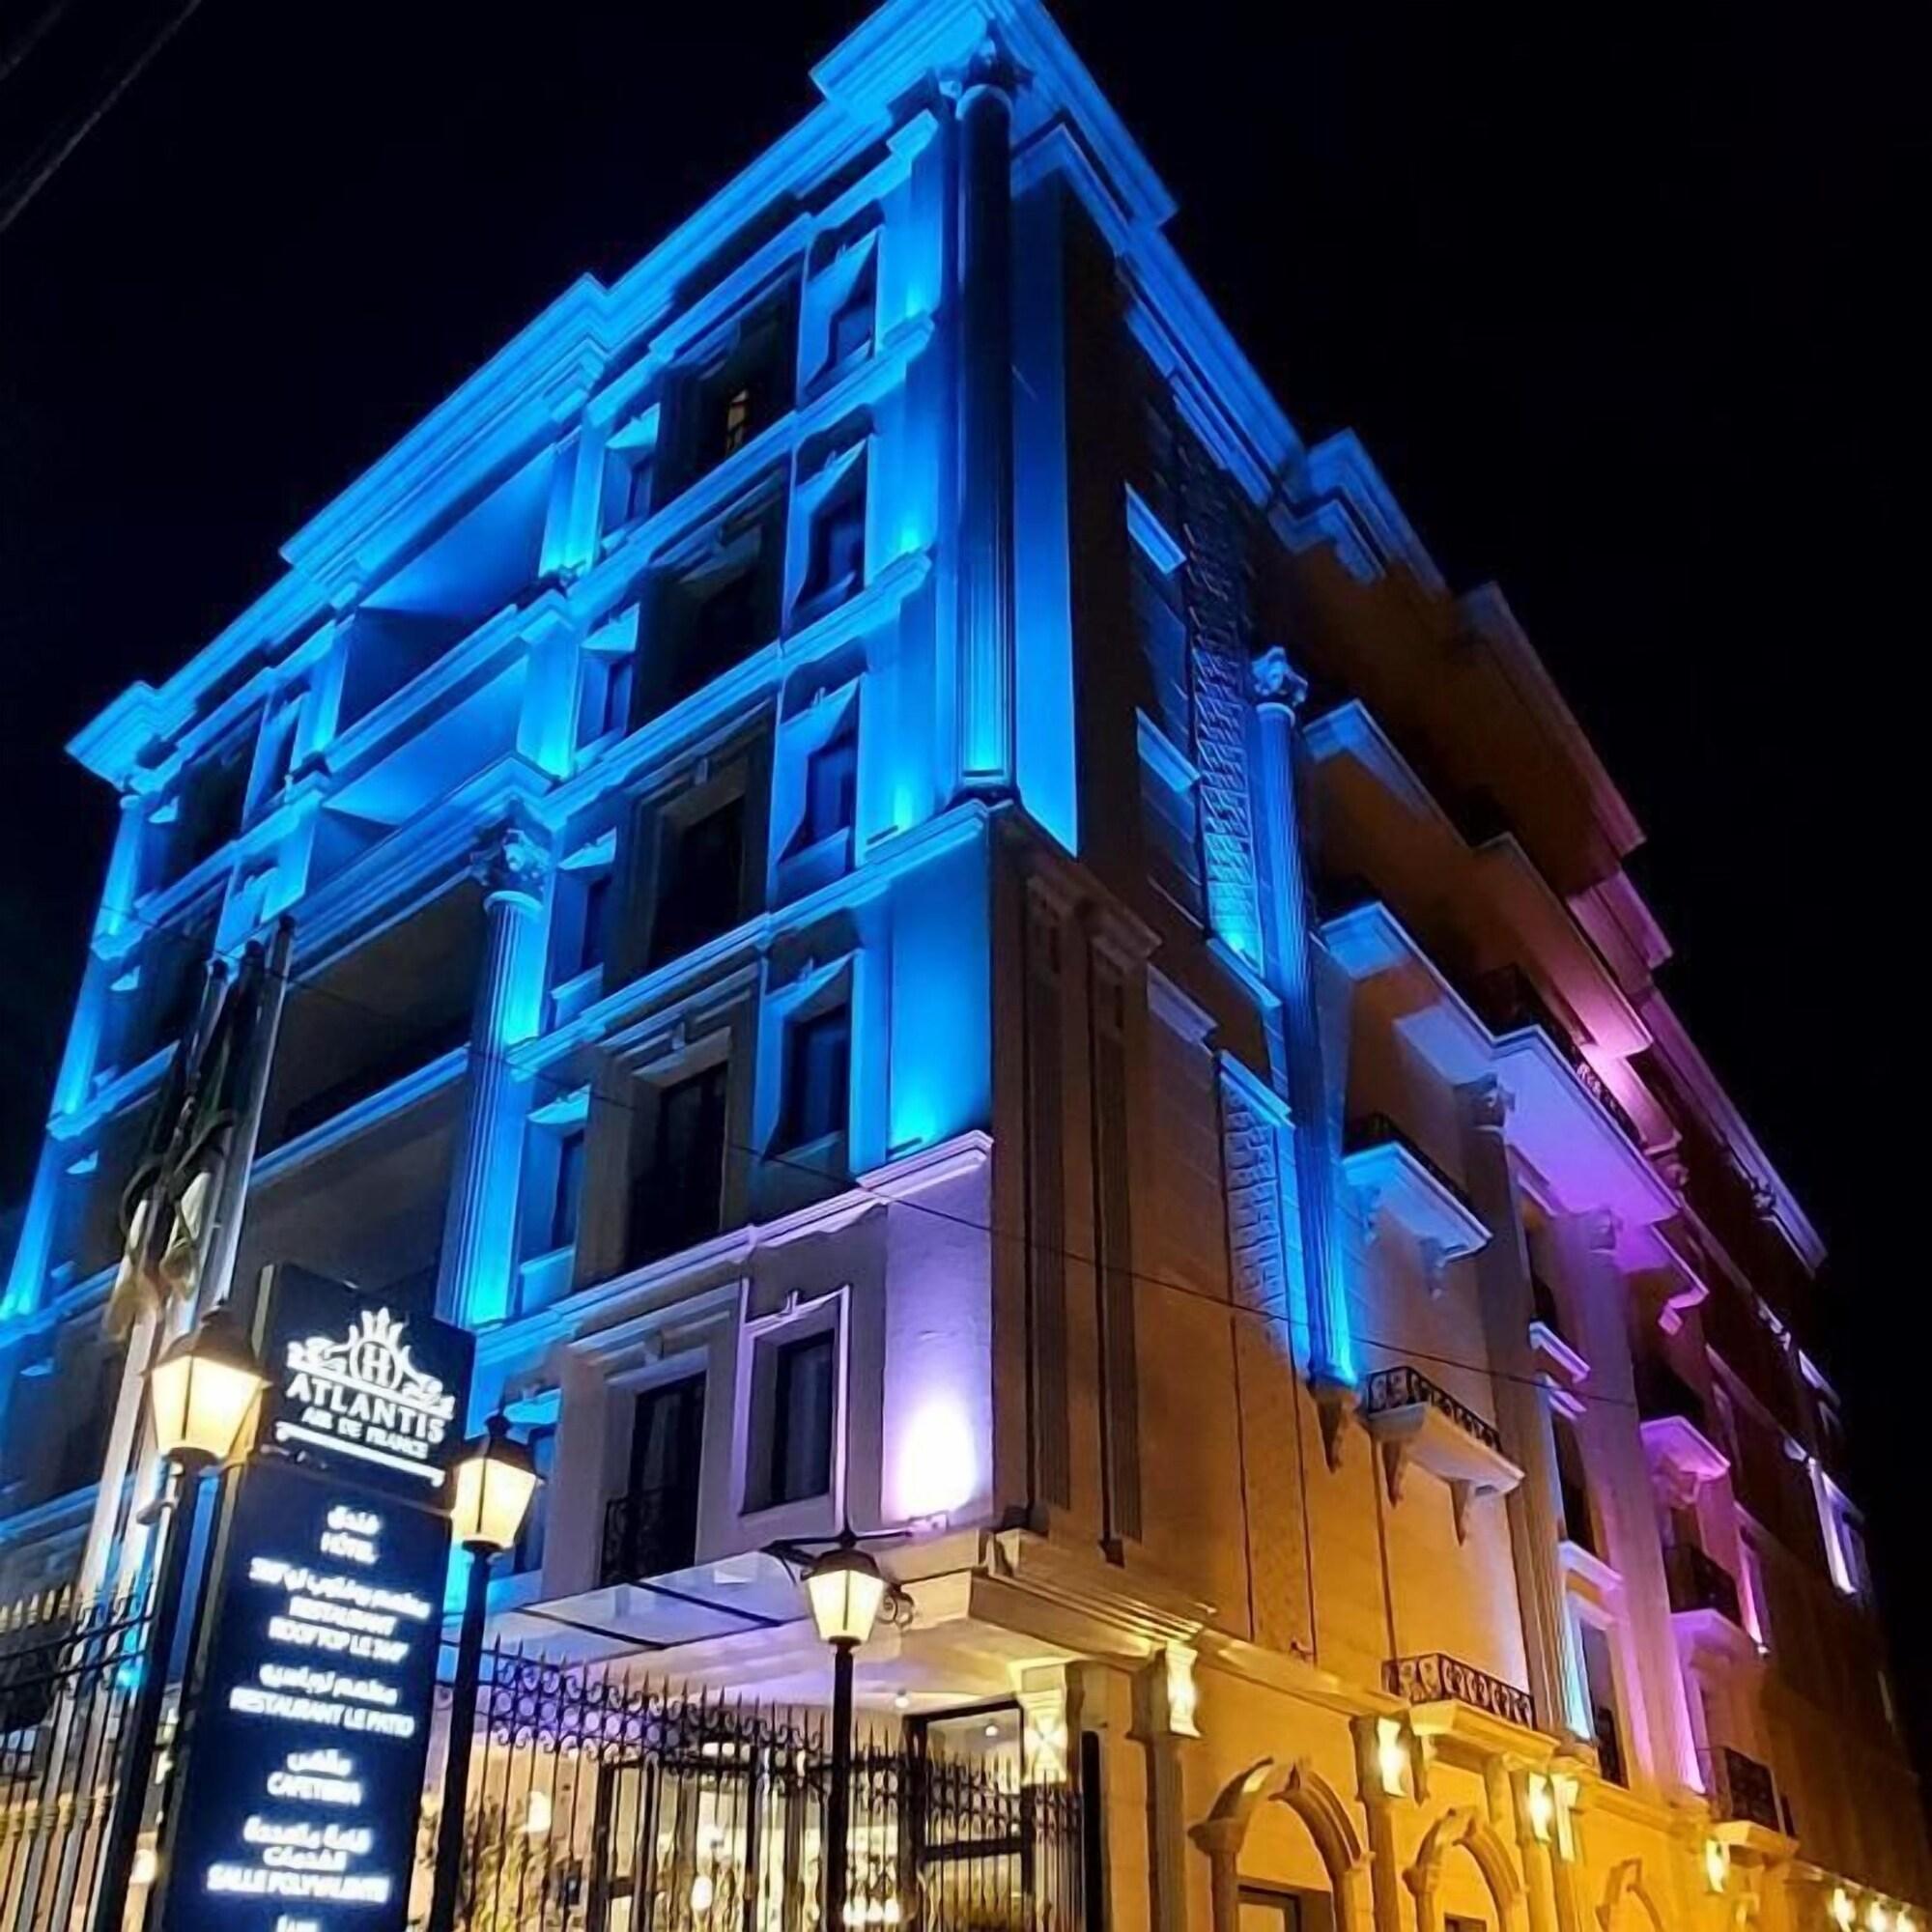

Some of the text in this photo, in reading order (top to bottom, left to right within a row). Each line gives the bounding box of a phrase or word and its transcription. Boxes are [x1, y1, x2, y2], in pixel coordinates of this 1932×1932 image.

[286, 1373, 445, 1444] ATLANTIS
[343, 1707, 367, 1730] LE
[365, 1711, 415, 1739] PATIO
